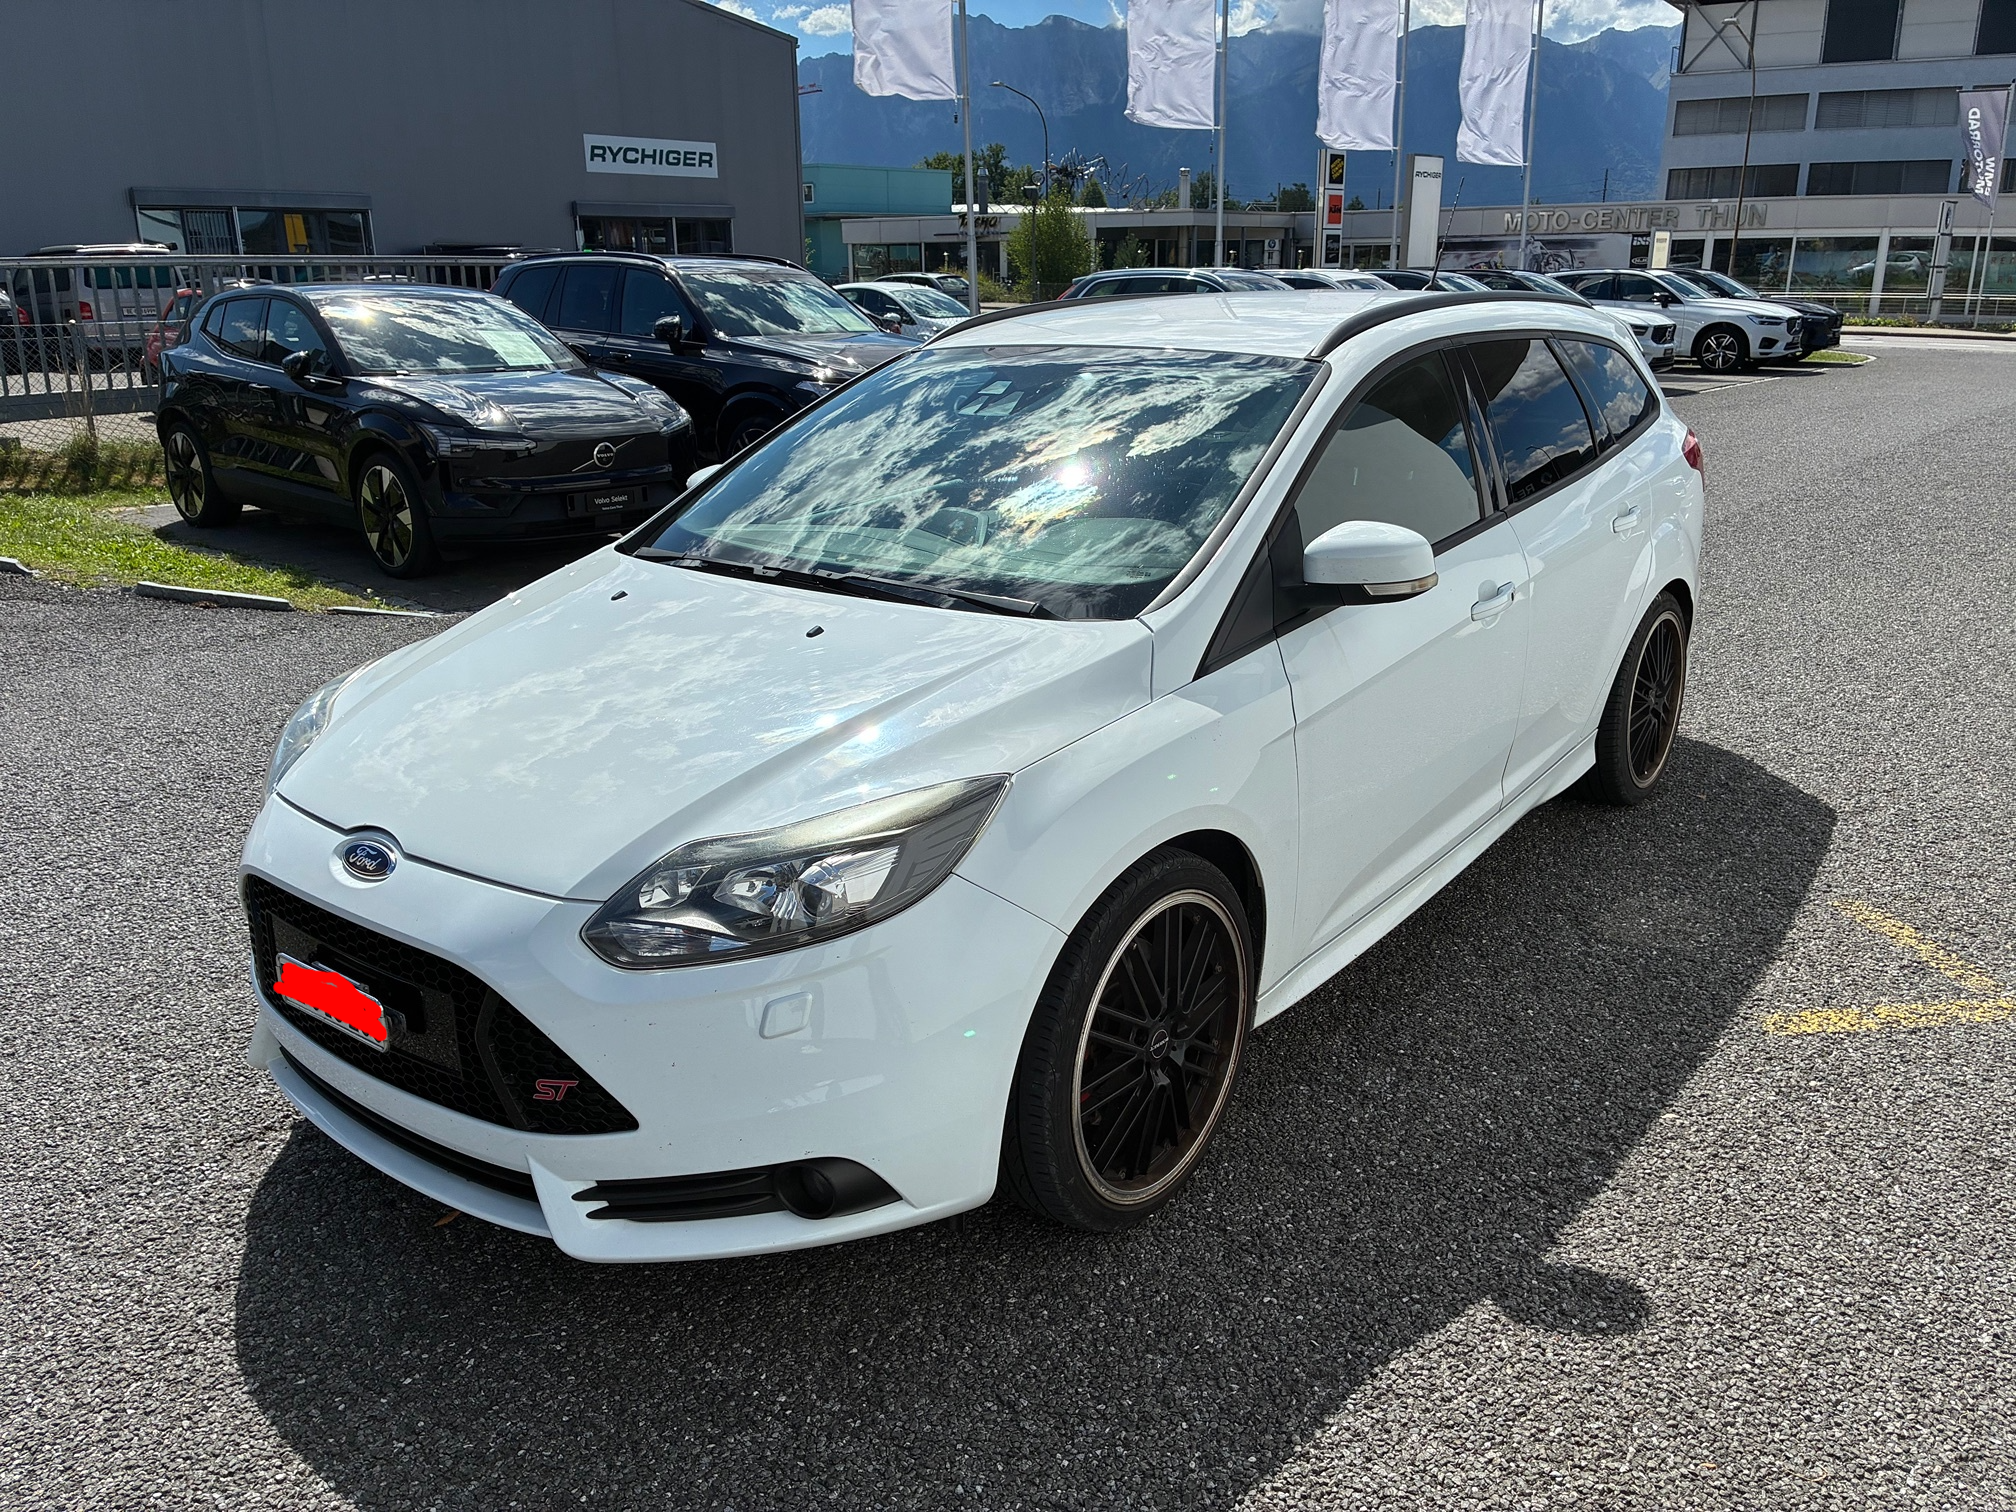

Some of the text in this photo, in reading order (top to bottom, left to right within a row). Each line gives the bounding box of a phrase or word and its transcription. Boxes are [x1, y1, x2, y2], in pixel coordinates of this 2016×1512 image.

[589, 144, 714, 169] RYCHIGER
[1414, 170, 1442, 179] RYCHIGER
[1503, 203, 1768, 233] MOTO-CENTER THUN
[594, 497, 610, 505] Volvo
[349, 846, 382, 870] Ford
[533, 1078, 579, 1101] ST
